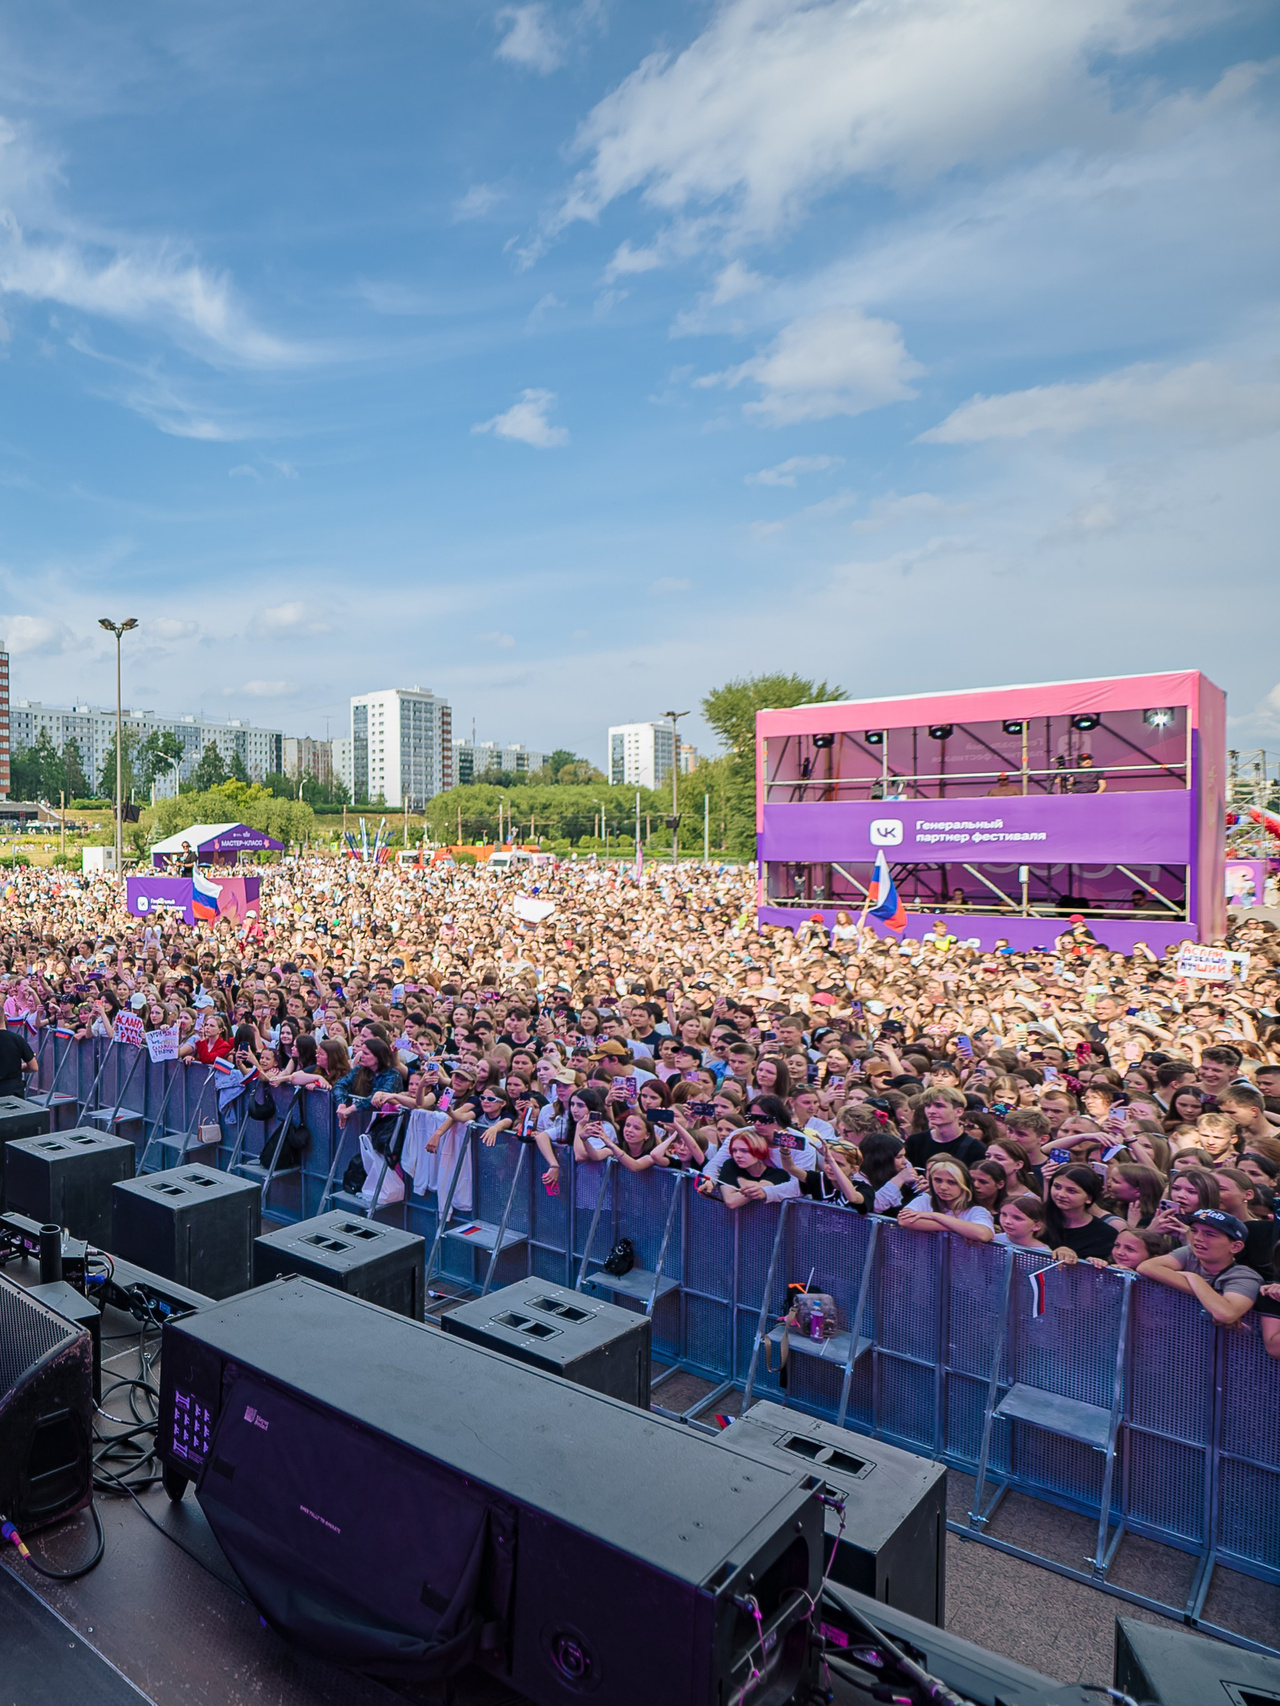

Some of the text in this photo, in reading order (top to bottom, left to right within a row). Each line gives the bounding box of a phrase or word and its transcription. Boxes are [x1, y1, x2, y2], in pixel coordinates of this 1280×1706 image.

[916, 819, 1003, 832] Генеральный
[876, 827, 896, 838] VK
[916, 831, 1047, 844] партнер фестиваля
[221, 839, 263, 847] МАСТЕР-КЛАСС
